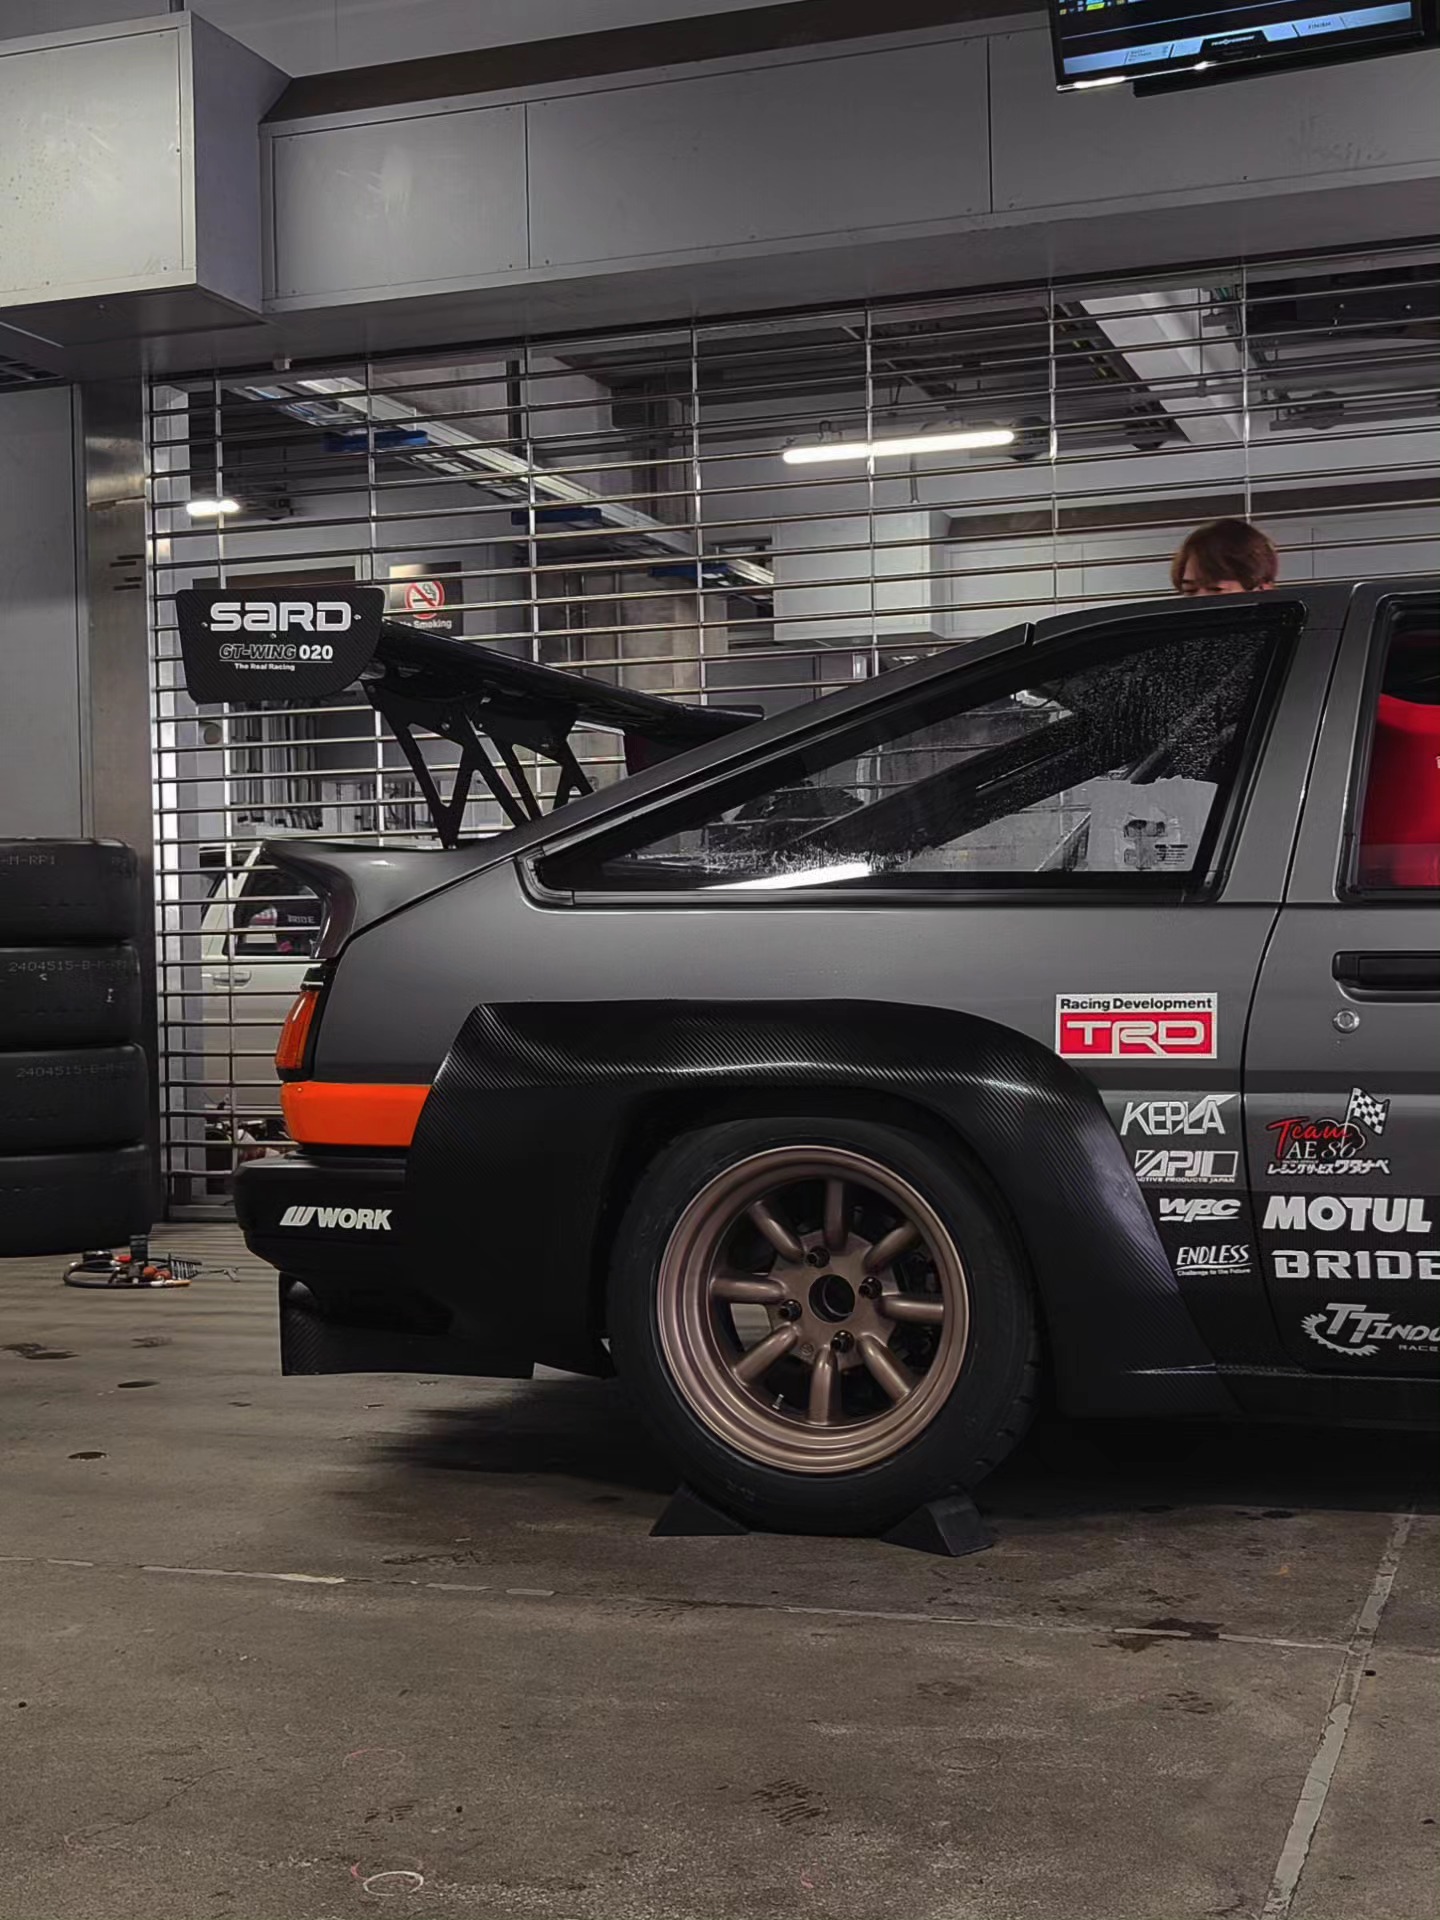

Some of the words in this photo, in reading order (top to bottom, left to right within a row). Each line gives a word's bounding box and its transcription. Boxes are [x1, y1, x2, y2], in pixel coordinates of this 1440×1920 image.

[219, 643, 297, 660] GT-WING
[299, 644, 334, 660] 020
[1060, 998, 1111, 1011] Racing
[1112, 998, 1213, 1011] Development
[1066, 1020, 1205, 1056] TRD
[1266, 1116, 1352, 1160] Team
[1262, 1195, 1433, 1233] MOTUL
[1176, 1244, 1250, 1266] ENDLESS
[1271, 1249, 1440, 1280] BRIDE
